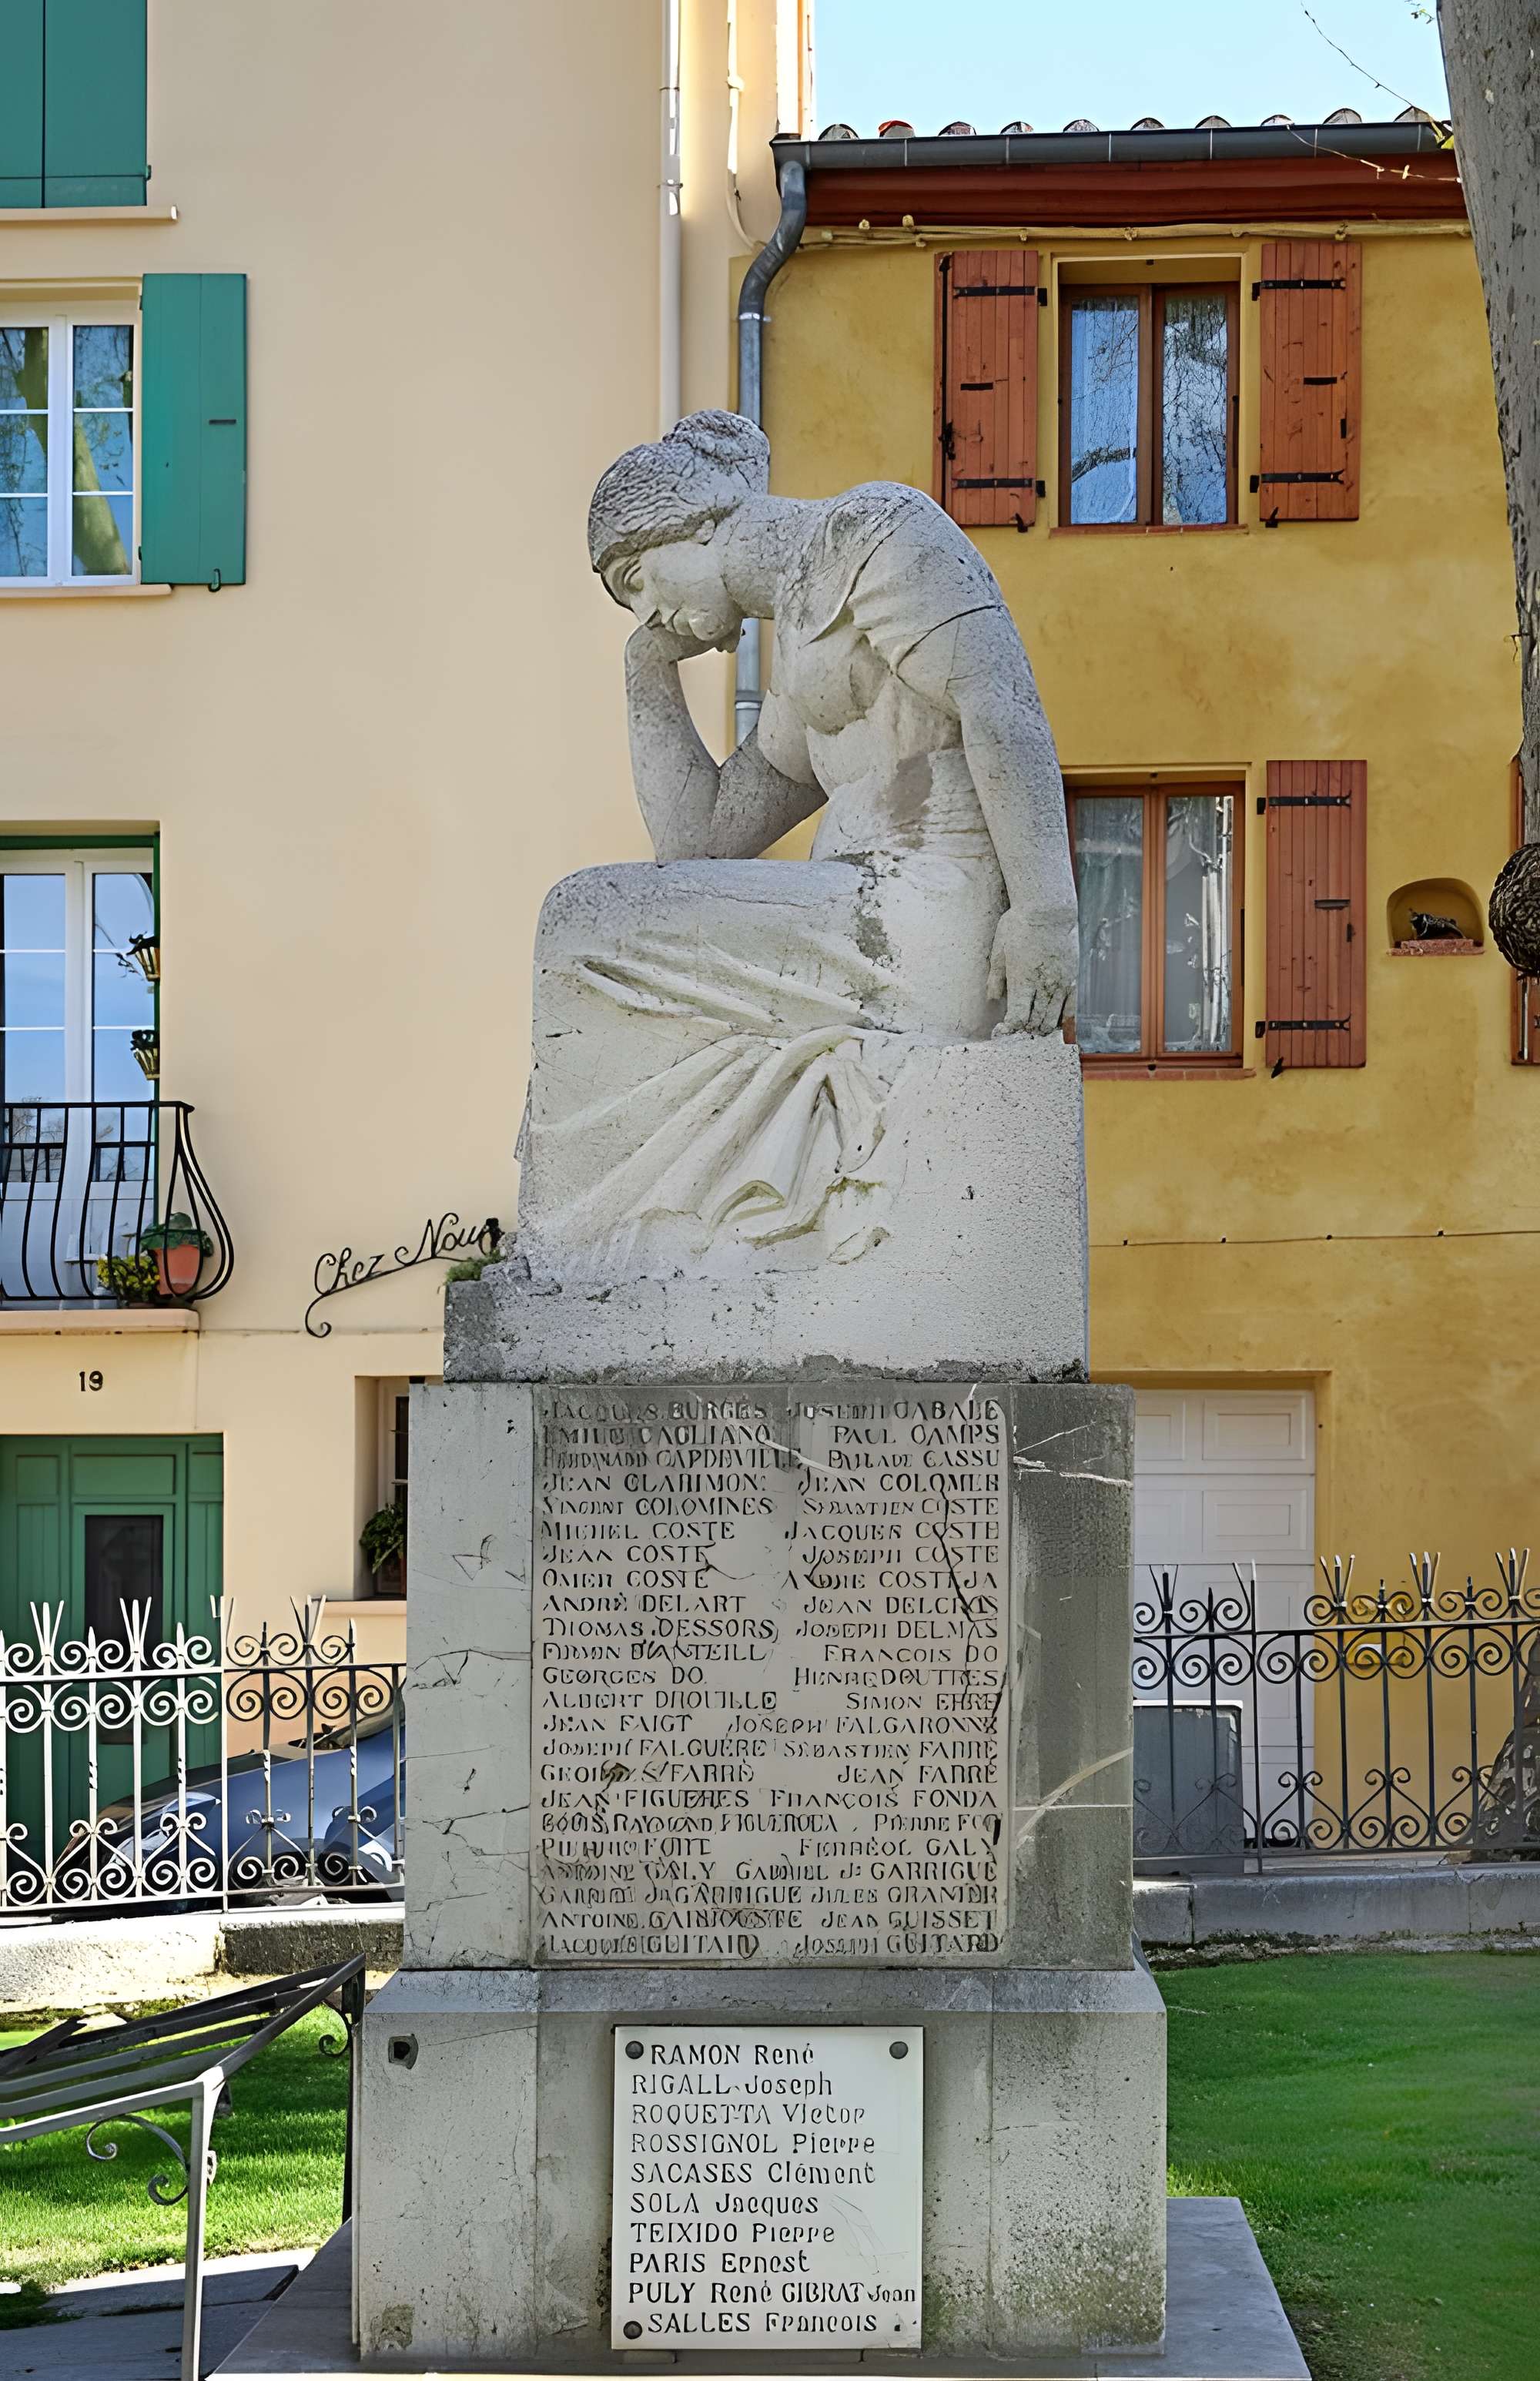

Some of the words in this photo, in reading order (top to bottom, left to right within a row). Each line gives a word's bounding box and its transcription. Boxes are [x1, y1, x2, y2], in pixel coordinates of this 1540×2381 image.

[314, 1247, 385, 1297] Chez
[79, 1370, 103, 1391] 19
[831, 1425, 897, 1445] PAUL
[543, 1472, 611, 1492] JEAN
[798, 1469, 865, 1493] JEAN
[921, 1497, 999, 1515] COSTE
[652, 1521, 735, 1540] COSTE
[915, 1521, 999, 1540] COSTE
[542, 1544, 614, 1564] JEAN
[626, 1544, 708, 1564] COSTE
[802, 1545, 902, 1565] JOSEPH
[915, 1545, 999, 1563] COSTE
[626, 1569, 708, 1588] COSTE
[803, 1595, 872, 1614] JEAN
[897, 1620, 998, 1639] DELMAS
[966, 1644, 999, 1663] DO
[845, 1692, 922, 1710] SIMON
[543, 1714, 606, 1733] JEAN
[837, 1764, 904, 1783] JEAN
[541, 1789, 611, 1810] JEAN
[913, 1789, 998, 1808] FONDA
[650, 2044, 741, 2065] RAMON
[754, 2042, 815, 2066] René
[631, 2074, 732, 2095] RIGALL
[745, 2071, 833, 2099] Joseph
[631, 2104, 772, 2125] ROQUETTA
[782, 2103, 865, 2125] Victor
[631, 2133, 778, 2154] ROSSIGNOL
[792, 2132, 876, 2155] Pierre
[630, 2162, 754, 2185] SACASES
[767, 2161, 876, 2185] Clément
[630, 2192, 701, 2214] SOLA
[715, 2192, 819, 2217] Jacques
[630, 2222, 738, 2244] TEIXIDO
[752, 2222, 835, 2244] Pierre
[628, 2252, 706, 2273] PARIS
[721, 2249, 811, 2274] Ernest
[628, 2282, 696, 2303] PULY
[710, 2279, 774, 2304] René
[782, 2282, 865, 2303] GIBRAT
[866, 2284, 916, 2303] Jean
[647, 2312, 751, 2334] SALLES
